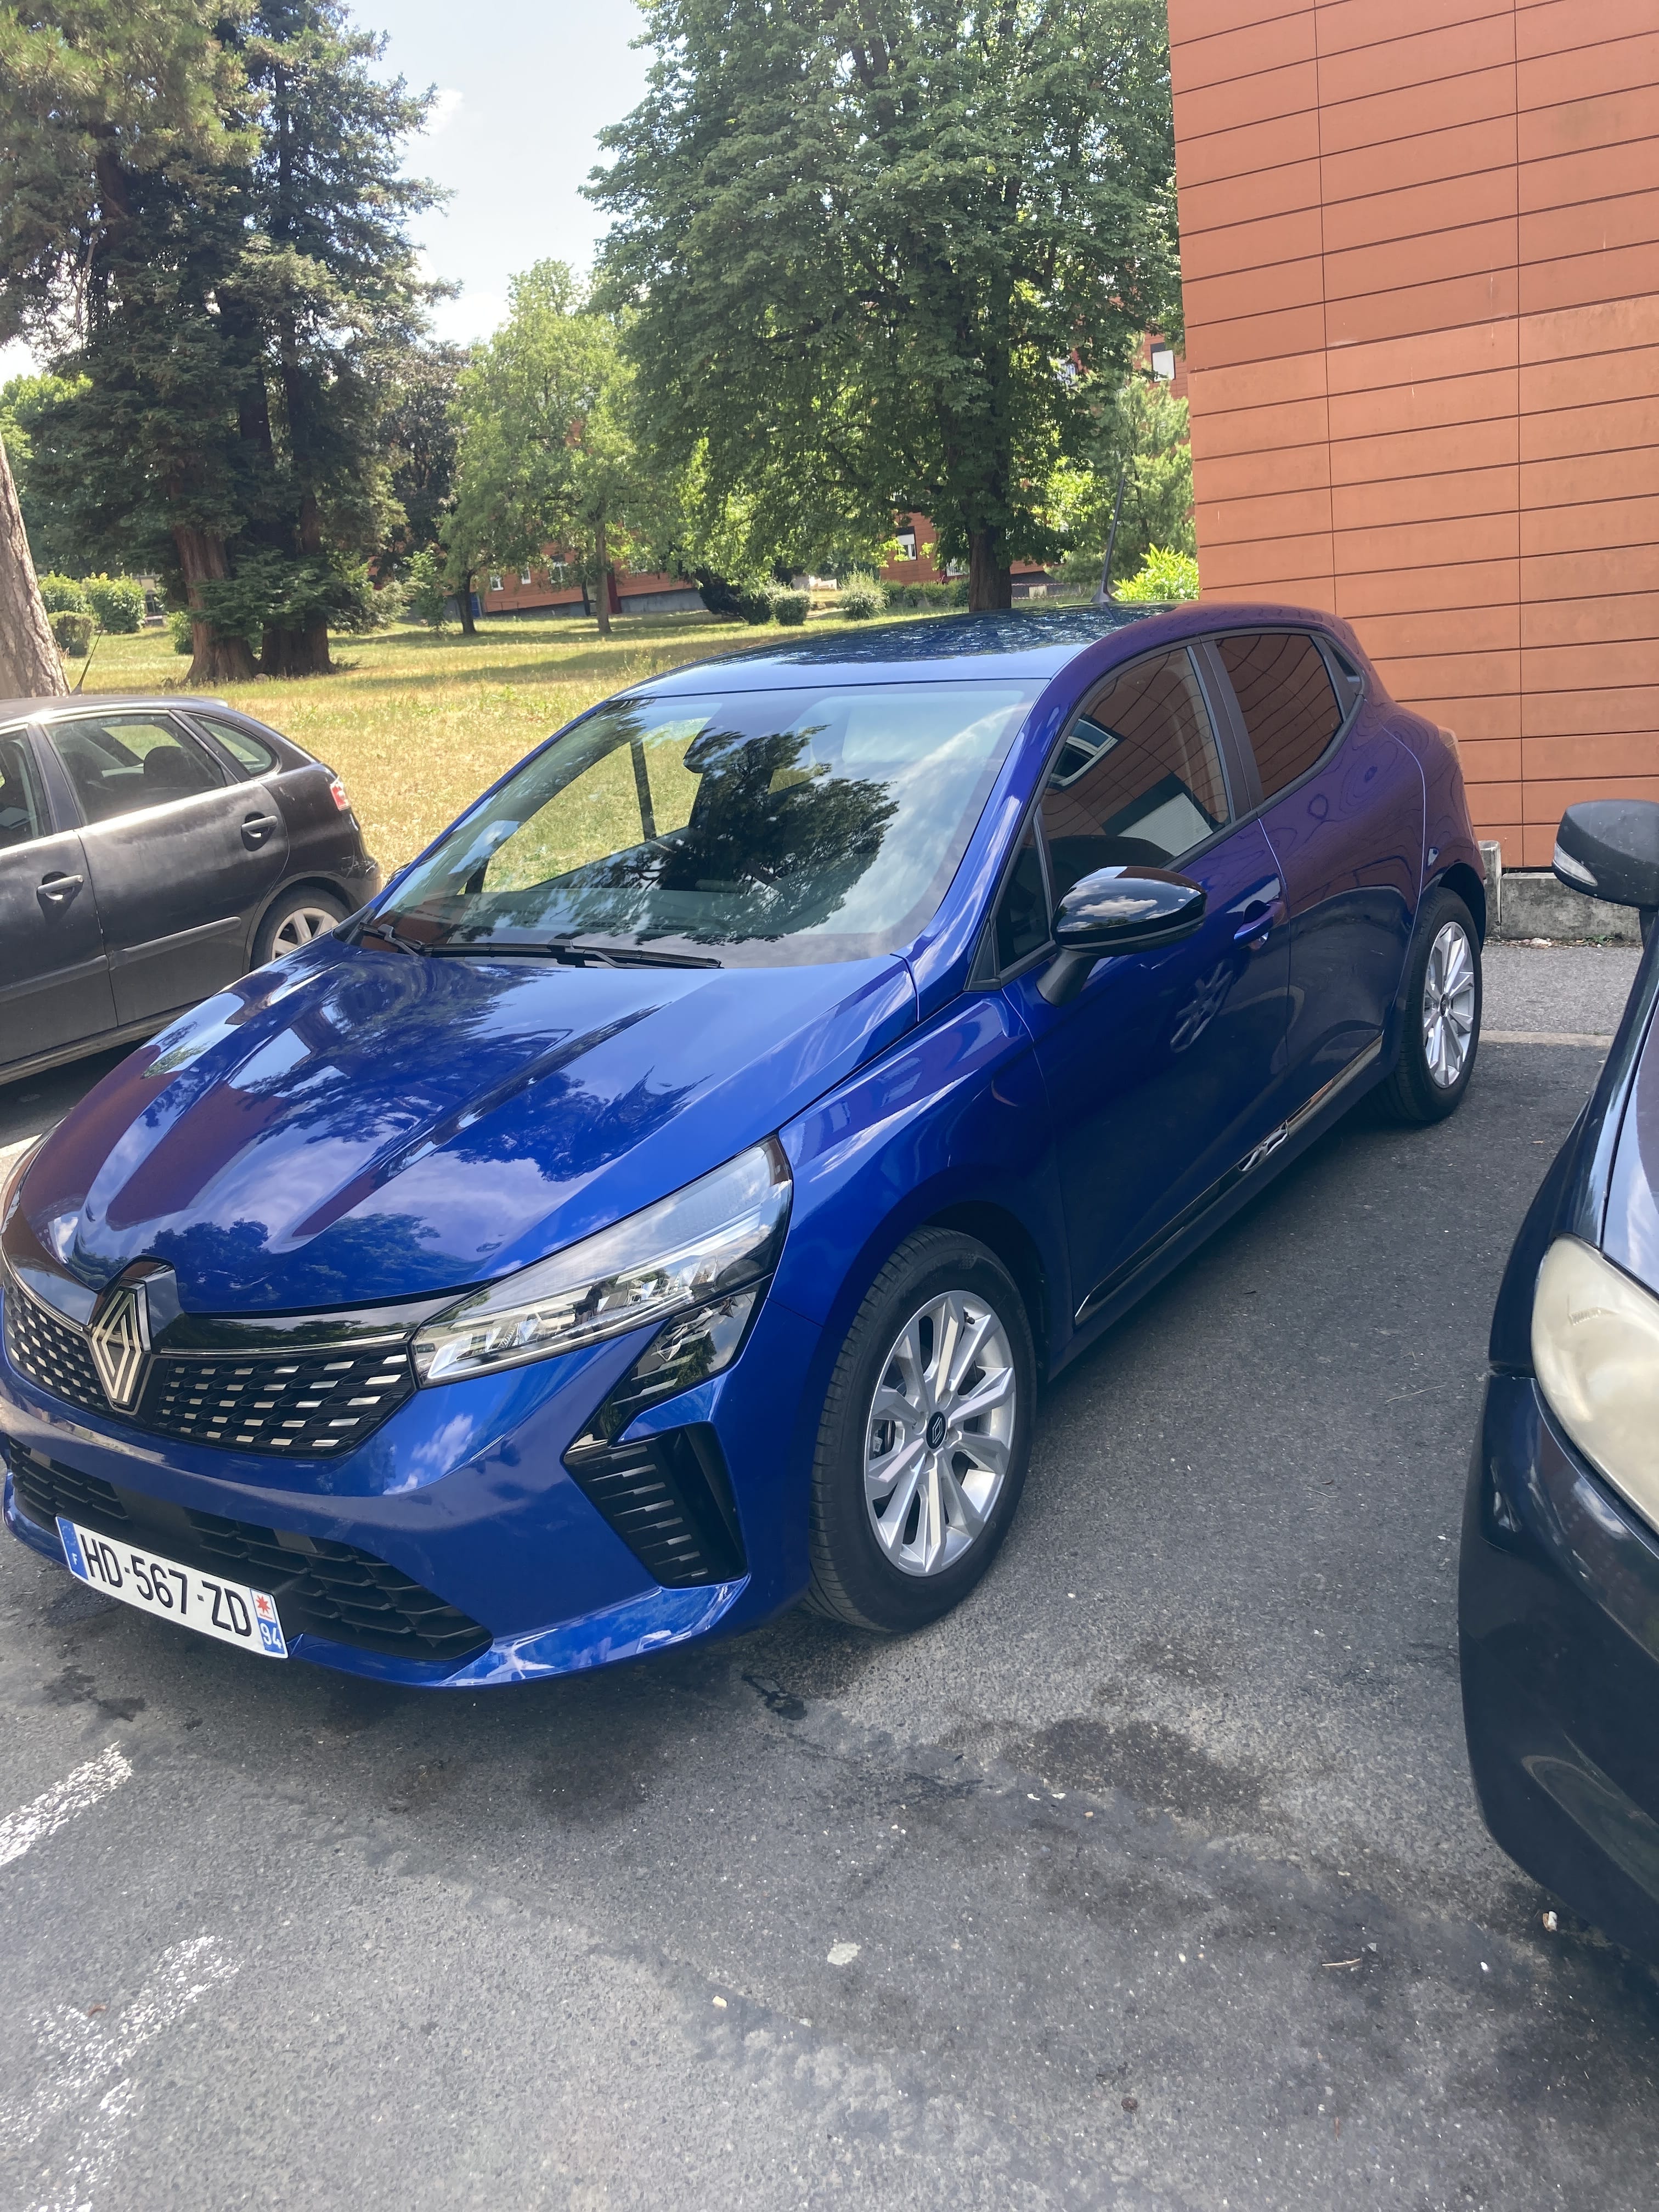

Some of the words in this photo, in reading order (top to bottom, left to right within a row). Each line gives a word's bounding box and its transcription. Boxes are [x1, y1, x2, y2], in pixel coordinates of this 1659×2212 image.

[72, 1553, 77, 1565] F
[80, 1533, 252, 1637] HD-567-ZD
[260, 1623, 283, 1649] 94
